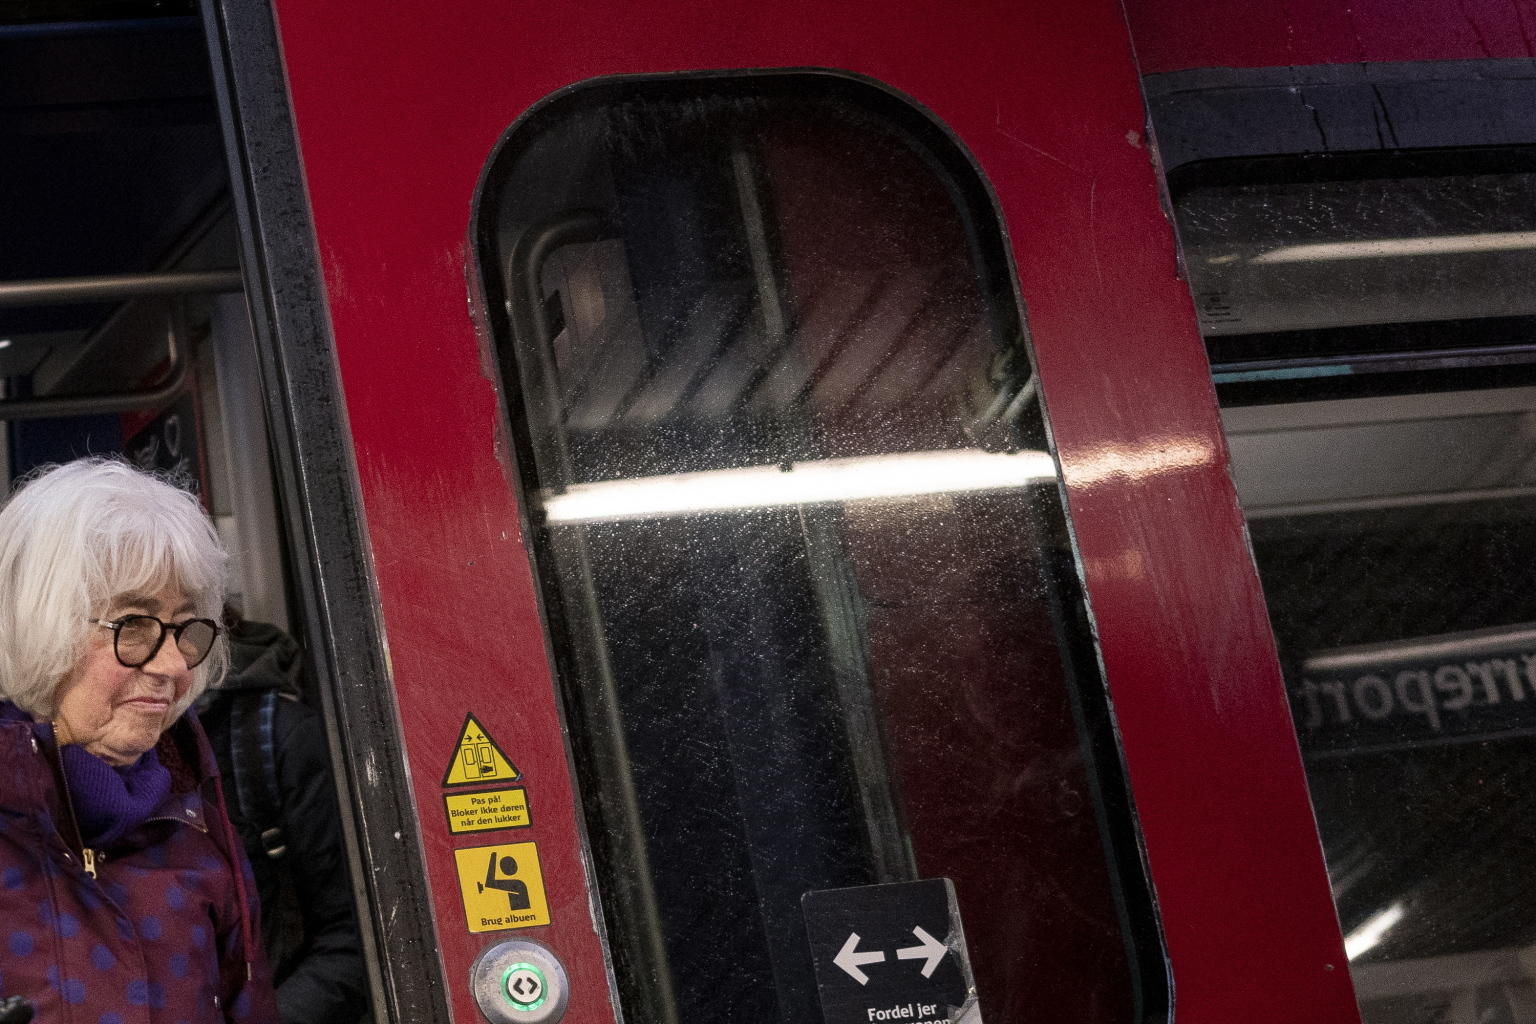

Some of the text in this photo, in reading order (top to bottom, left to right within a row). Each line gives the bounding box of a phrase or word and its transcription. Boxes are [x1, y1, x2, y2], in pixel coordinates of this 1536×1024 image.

[471, 795, 501, 806] Pas på!
[450, 804, 525, 818] Bloker ikke døren
[461, 814, 521, 827] når den lukker
[480, 914, 536, 926] Brug albuen
[867, 1003, 937, 1022] Fordel jer
